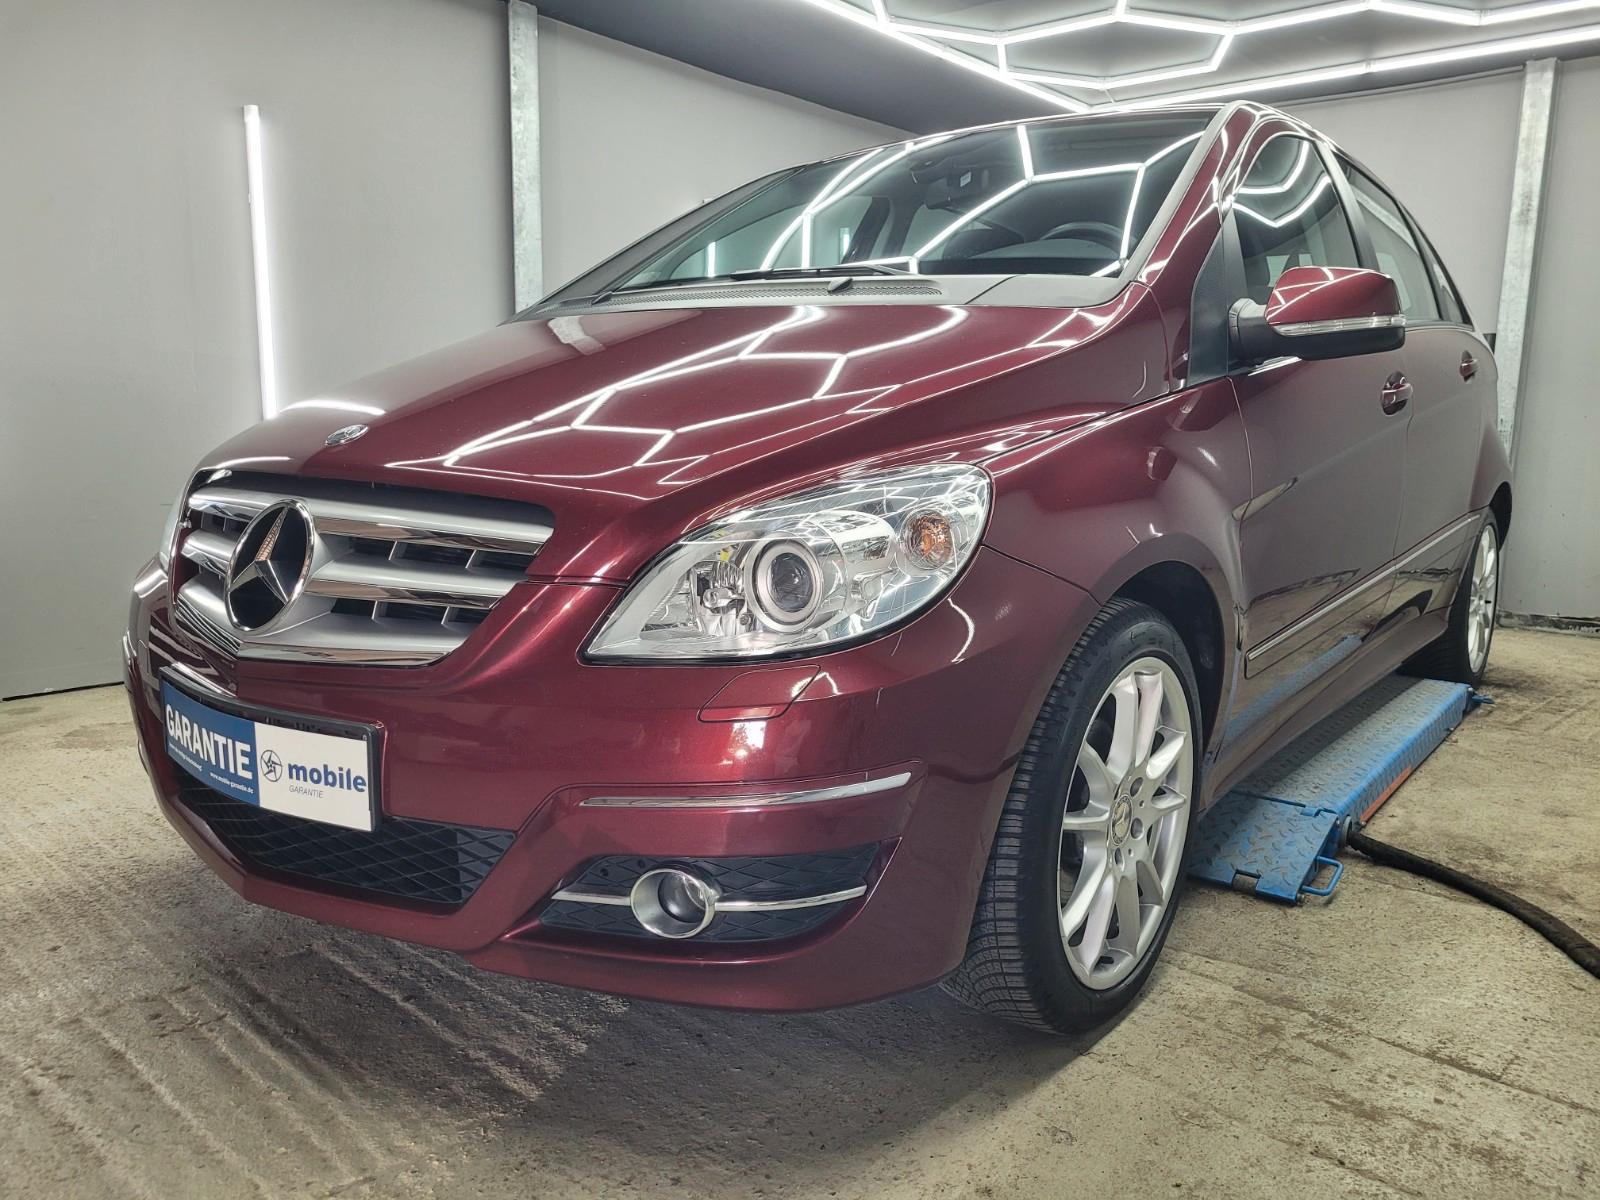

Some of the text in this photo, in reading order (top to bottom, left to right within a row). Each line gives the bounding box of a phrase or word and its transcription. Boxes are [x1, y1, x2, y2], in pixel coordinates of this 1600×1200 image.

[166, 704, 253, 780] GARANTIE
[288, 763, 367, 793] mobile
[289, 785, 324, 799] GARANTIE
